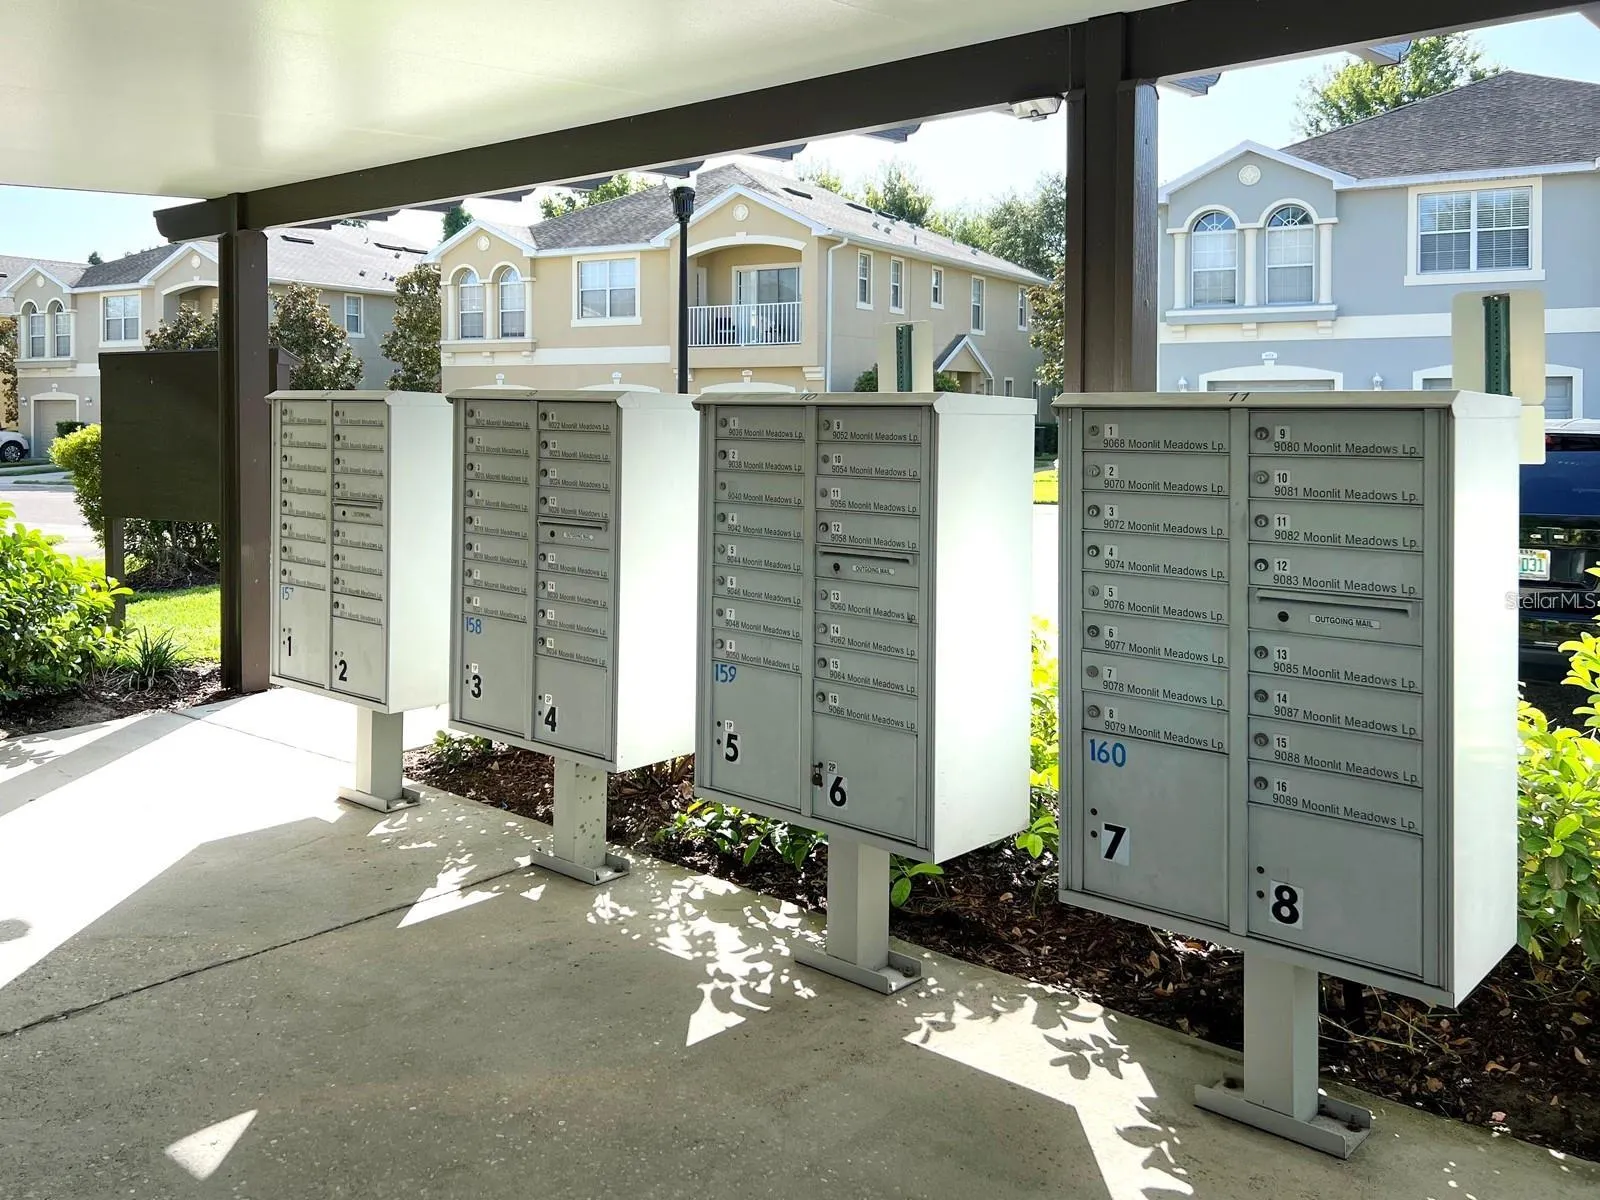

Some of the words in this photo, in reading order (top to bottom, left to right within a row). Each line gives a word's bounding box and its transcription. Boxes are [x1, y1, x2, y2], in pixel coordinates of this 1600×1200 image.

[744, 429, 764, 437] Moonlit
[833, 432, 848, 440] 9052
[850, 432, 873, 440] Moonlit
[875, 432, 907, 441] Meadows
[1108, 427, 1112, 435] 1
[1280, 429, 1285, 439] 9
[1103, 439, 1125, 448] 9068
[1128, 440, 1160, 449] Moonlit
[1164, 440, 1208, 450] Meadows
[1212, 441, 1226, 452] Lp.
[1274, 442, 1300, 452] 9080
[1304, 443, 1341, 453] Moonlit
[1346, 443, 1398, 454] Meadows
[1402, 444, 1419, 455] Lp.
[835, 455, 841, 463] 10
[832, 465, 847, 473] 9054
[850, 466, 872, 474] Moonlit
[875, 467, 906, 476] Meadows
[1109, 467, 1113, 476] 2
[1277, 473, 1287, 483] 10
[1104, 480, 1125, 489] 9070
[1128, 481, 1160, 490] Moonlit
[1164, 482, 1207, 492] Meadows
[1212, 484, 1224, 493] Lp.
[1275, 486, 1298, 496] 9081
[1303, 488, 1340, 498] Moonlit
[1345, 489, 1397, 500] Meadows
[1402, 490, 1418, 502] Lp.
[830, 500, 846, 508] 9056
[848, 501, 872, 509] Moonlit
[874, 502, 905, 512] Meadows
[1109, 507, 1113, 516] 3
[833, 524, 840, 532] 12
[1104, 520, 1124, 529] 9072
[1128, 521, 1160, 532] Moonlit
[1163, 523, 1207, 534] Meadows
[1211, 526, 1224, 536] Lp.
[1277, 517, 1286, 527] 11
[831, 534, 847, 542] 9058
[849, 536, 872, 544] Moonlit
[874, 538, 905, 548] Meadows
[1275, 530, 1299, 541] 9082
[1304, 532, 1341, 544] Moonlit
[1346, 534, 1398, 546] Meadows
[1403, 538, 1419, 549] Lp.
[1109, 547, 1113, 557] 4
[1104, 559, 1124, 569] 9074
[1128, 561, 1160, 573] Moonlit
[1164, 564, 1207, 577] Meadows
[1211, 568, 1224, 579] Lp.
[1277, 561, 1287, 571] 12
[1522, 558, 1544, 572] 031
[1273, 575, 1298, 585] 9083
[1303, 577, 1340, 589] Moonlit
[1345, 580, 1397, 593] Meadows
[1401, 584, 1418, 595] Lp.
[832, 592, 839, 600] 13
[1108, 588, 1113, 597] 5
[1104, 600, 1124, 610] 9076
[1128, 602, 1159, 614] Moonlit
[1163, 606, 1207, 619] Meadows
[1211, 610, 1224, 621] Lp.
[465, 617, 482, 634] 158
[1315, 616, 1353, 626] OUTGOING
[1356, 619, 1373, 627] MAIL
[832, 626, 838, 634] 14
[1109, 628, 1113, 638] 6
[287, 636, 292, 656] 1
[1104, 640, 1125, 650] 9077
[1129, 643, 1160, 656] Moonlit
[1164, 647, 1208, 662] Meadows
[1212, 653, 1225, 664] Lp.
[1277, 650, 1287, 659] 13
[741, 653, 761, 663] Moonlit
[763, 657, 790, 670] Meadows
[832, 661, 838, 669] 15
[339, 660, 347, 681] 2
[715, 664, 736, 683] 159
[1107, 669, 1112, 678] 7
[1274, 663, 1298, 674] 9085
[1303, 666, 1340, 679] Moonlit
[1344, 670, 1396, 686] Meadows
[1401, 678, 1417, 689] Lp.
[471, 674, 481, 698] 3
[1103, 681, 1124, 692] 9078
[1128, 684, 1159, 697] Moonlit
[1163, 689, 1207, 704] Meadows
[1211, 695, 1224, 707] Lp.
[1277, 693, 1287, 703] 14
[544, 706, 556, 732] 4
[829, 705, 844, 715] 9066
[847, 709, 870, 720] Moonlit
[872, 714, 904, 727] Meadows
[1109, 709, 1113, 718] 8
[726, 722, 732, 730] 1P
[1274, 706, 1299, 718] 9087
[1304, 710, 1340, 724] Moonlit
[1345, 716, 1397, 733] Meadows
[1402, 724, 1417, 736] Lp.
[1104, 721, 1125, 732] 9079
[1129, 725, 1160, 739] Moonlit
[1164, 731, 1208, 747] Meadows
[1212, 738, 1224, 749] Lp.
[725, 733, 738, 762] 5
[1276, 737, 1287, 748] 15
[1089, 739, 1126, 768] 160
[1275, 750, 1300, 763] 9088
[1304, 755, 1342, 770] Moonlit
[1346, 762, 1398, 780] Meadows
[1403, 771, 1419, 783] Lp.
[829, 776, 847, 807] 6
[1277, 781, 1287, 792] 16
[1273, 793, 1298, 806] 9089
[1302, 799, 1339, 815] Moonlit
[1344, 807, 1396, 825] Meadows
[1401, 818, 1417, 831] Lp.
[1104, 823, 1126, 860] 7
[1271, 884, 1299, 925] 8
